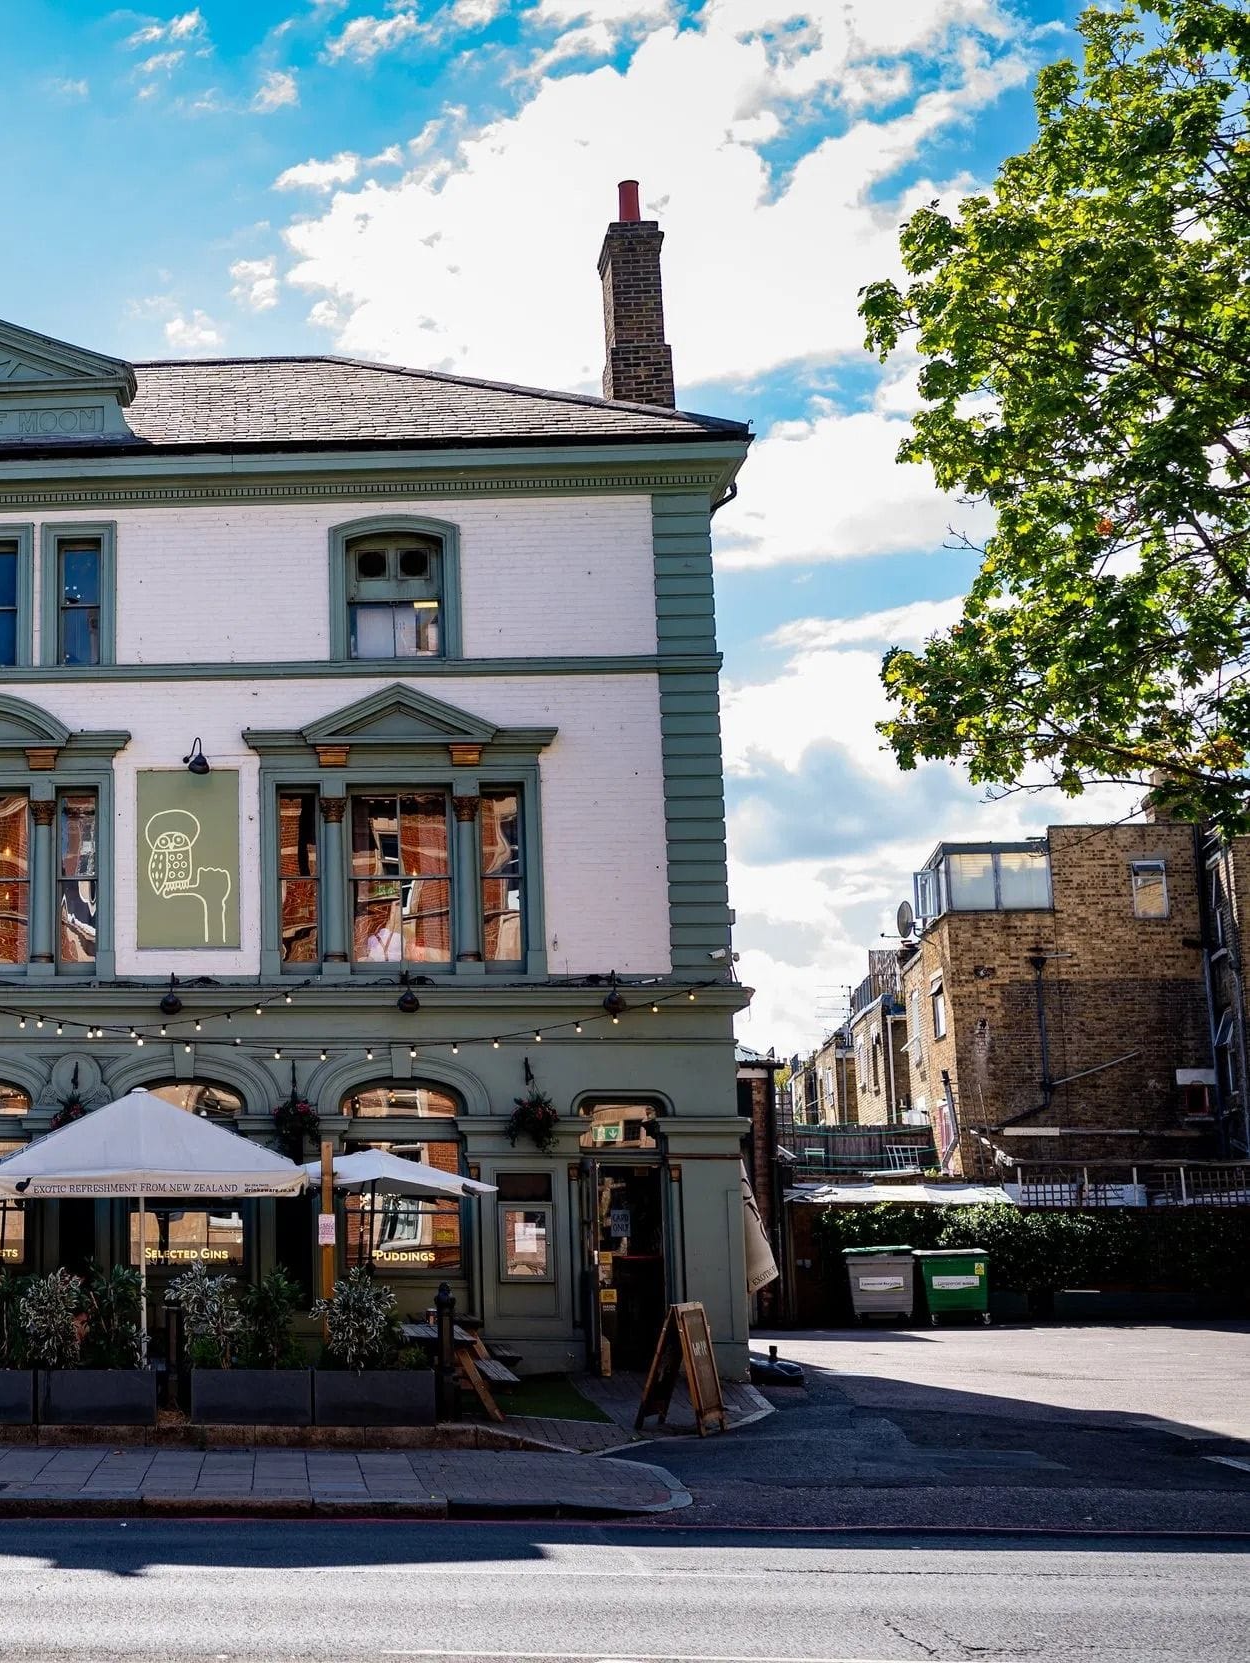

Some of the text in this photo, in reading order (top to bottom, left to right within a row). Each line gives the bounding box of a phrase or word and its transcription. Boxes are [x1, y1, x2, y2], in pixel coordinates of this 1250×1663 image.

[18, 410, 96, 433] MOON
[33, 1183, 238, 1194] EXOTIC REFRESHMENT FROM NEW ZEALAND
[145, 1247, 229, 1259] SELECTED GINS
[376, 1250, 436, 1262] PUDDINGS
